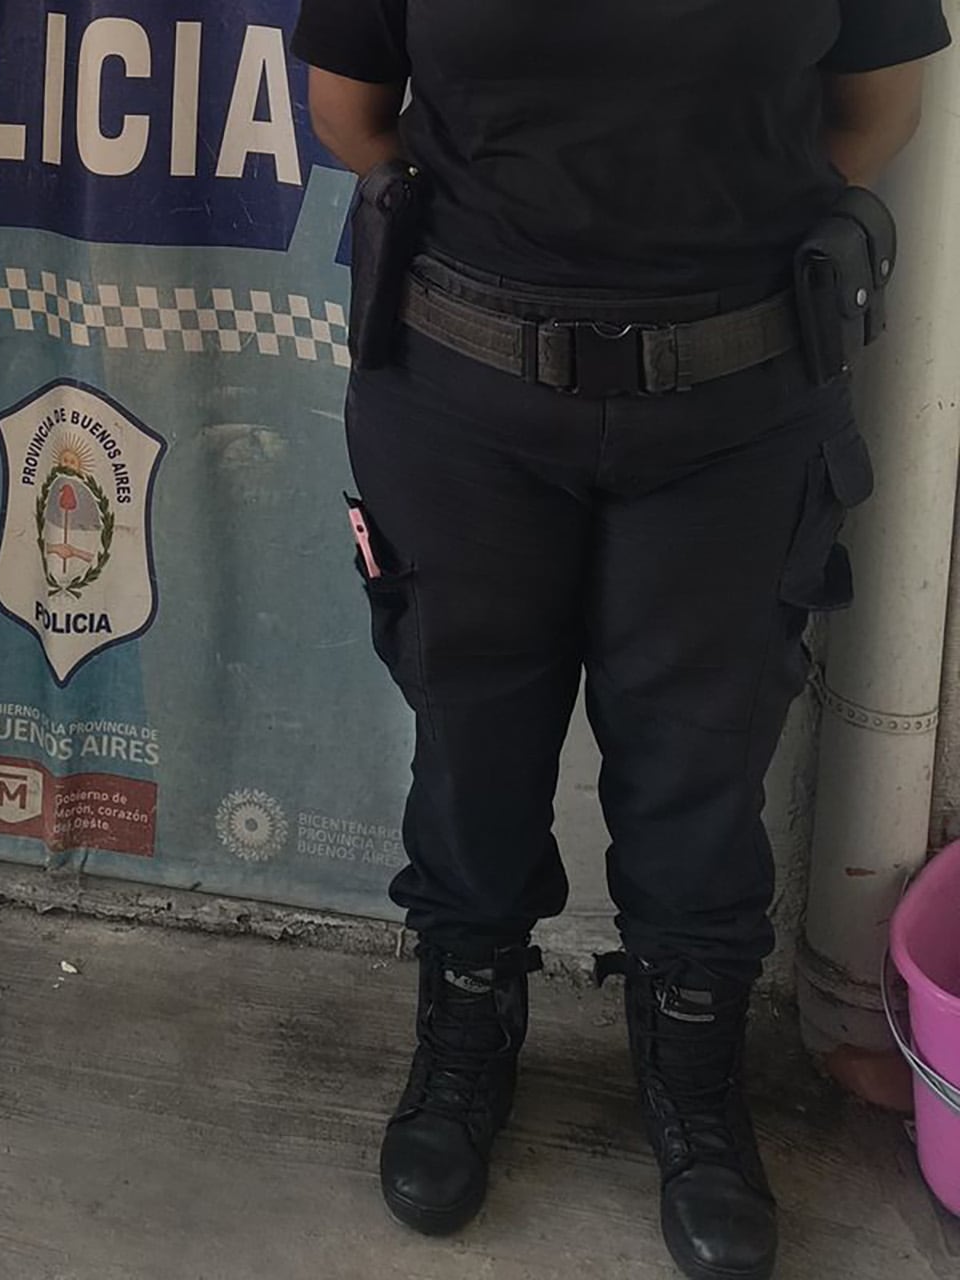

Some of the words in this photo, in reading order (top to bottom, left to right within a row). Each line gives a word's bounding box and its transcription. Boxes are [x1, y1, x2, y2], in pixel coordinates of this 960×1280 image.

[22, 416, 55, 485] PROVINCIA
[71, 410, 122, 460] BUENOS
[112, 463, 132, 504] AIRES
[35, 601, 112, 633] POLICIA
[51, 722, 66, 736] LA
[69, 720, 138, 739] PROVINCIA
[142, 727, 159, 741] DE
[80, 735, 160, 765] AIRES
[112, 792, 129, 806] de
[97, 806, 149, 824] corazón
[297, 826, 375, 850] PROVINCIA
[297, 840, 357, 861] BUENOS
